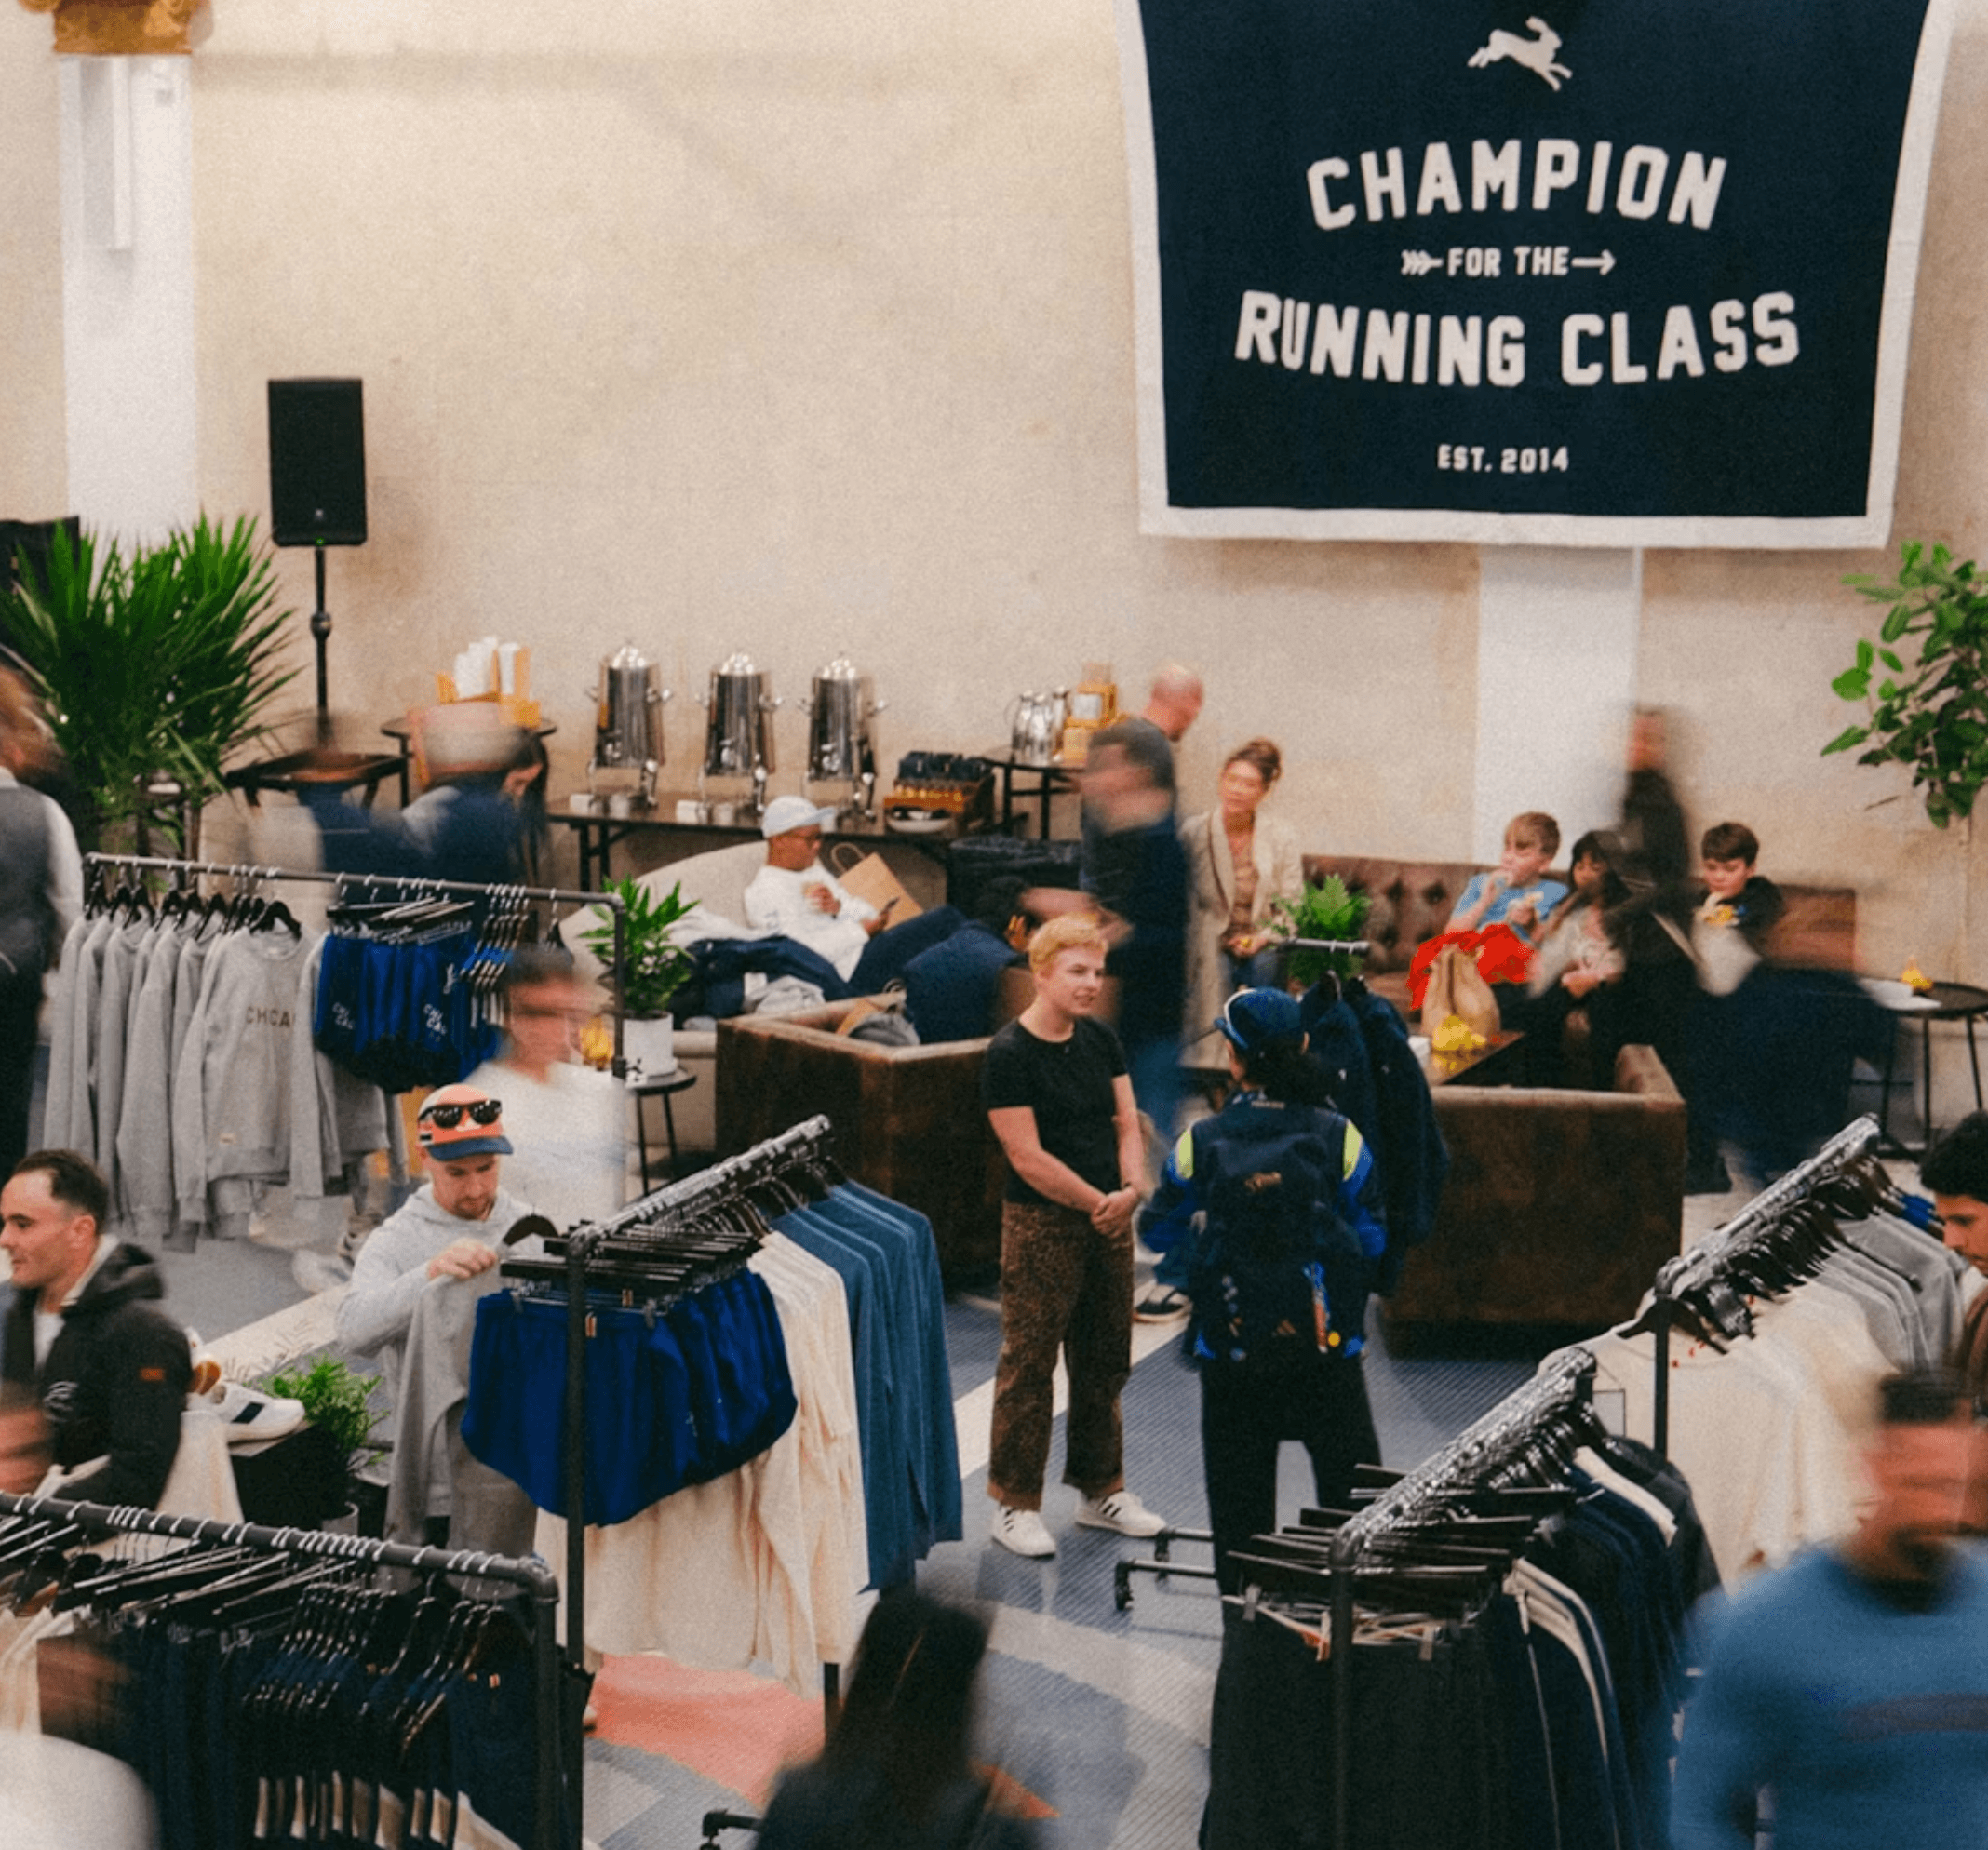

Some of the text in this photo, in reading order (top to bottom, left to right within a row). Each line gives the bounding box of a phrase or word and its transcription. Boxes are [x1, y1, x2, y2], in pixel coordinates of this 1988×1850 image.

[1307, 139, 1726, 230] CHAMPION
[1447, 246, 1569, 277] FOR THE
[1235, 290, 1799, 387] RUNNING CLASS
[1438, 444, 1568, 473] EST. 2014
